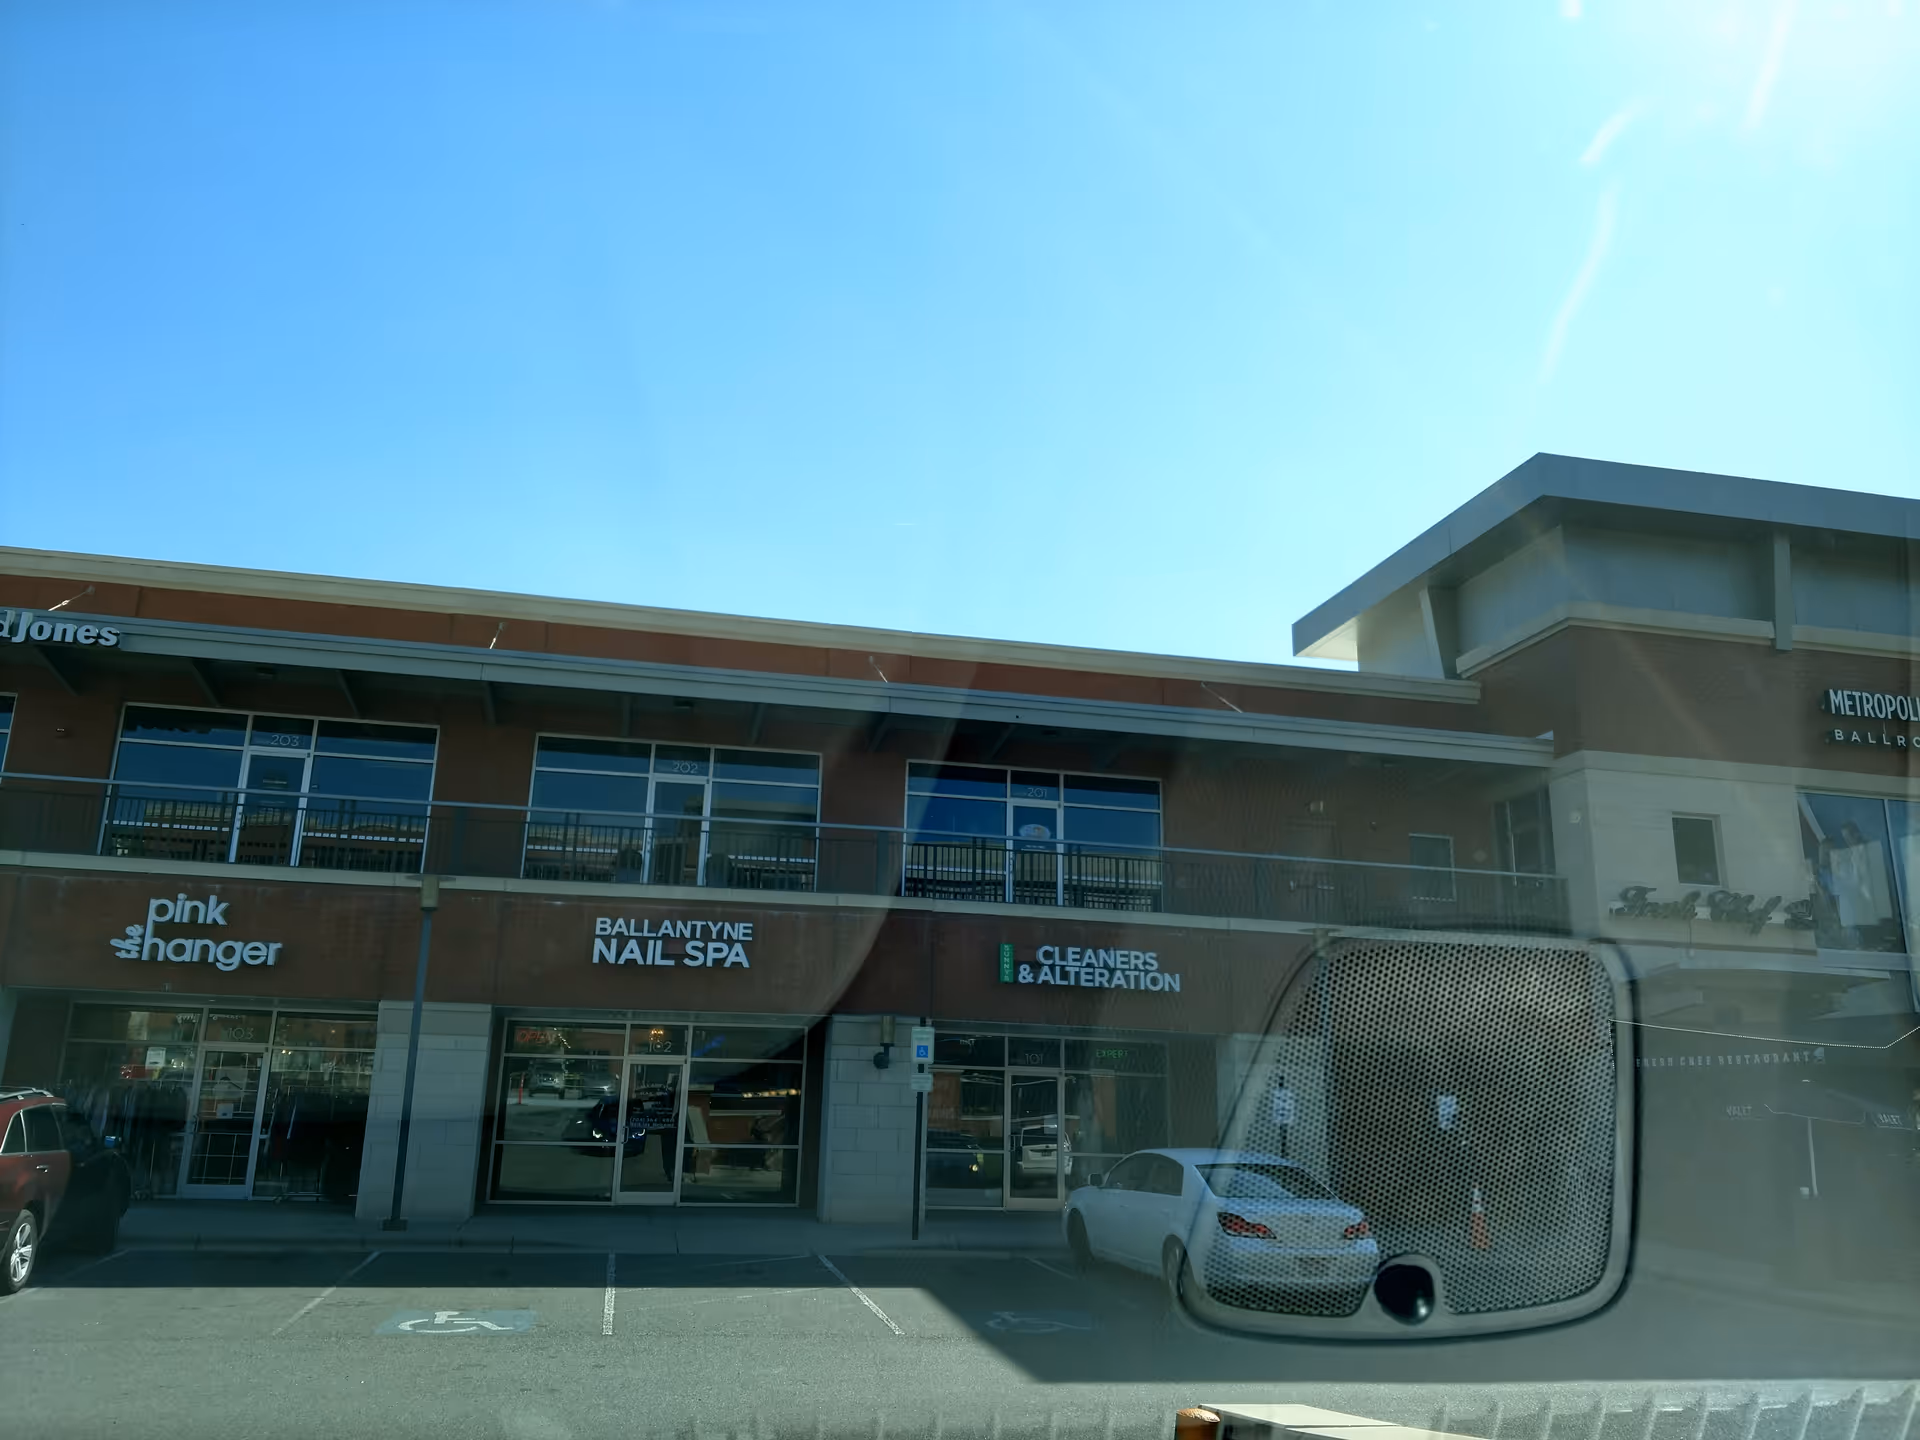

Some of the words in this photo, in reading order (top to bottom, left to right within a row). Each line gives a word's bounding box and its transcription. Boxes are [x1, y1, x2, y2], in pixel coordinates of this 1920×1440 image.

[271, 734, 299, 747] 203
[673, 762, 698, 774] 202
[1027, 787, 1047, 798] 201
[148, 893, 230, 926] pink
[595, 917, 753, 941] BALLANTYNE
[109, 924, 144, 959] the
[141, 926, 283, 971] hanger
[592, 938, 675, 966] NAIL
[682, 940, 750, 968] SPA
[1037, 945, 1159, 971] CLEANERS
[1018, 964, 1034, 984] &
[1037, 965, 1181, 992] ALTERATION
[228, 1027, 254, 1040] 103
[649, 1041, 672, 1053] 102
[1096, 1049, 1128, 1059] EXPERT
[1025, 1053, 1043, 1065] 101
[1718, 1051, 1810, 1065] RESTAURANT
